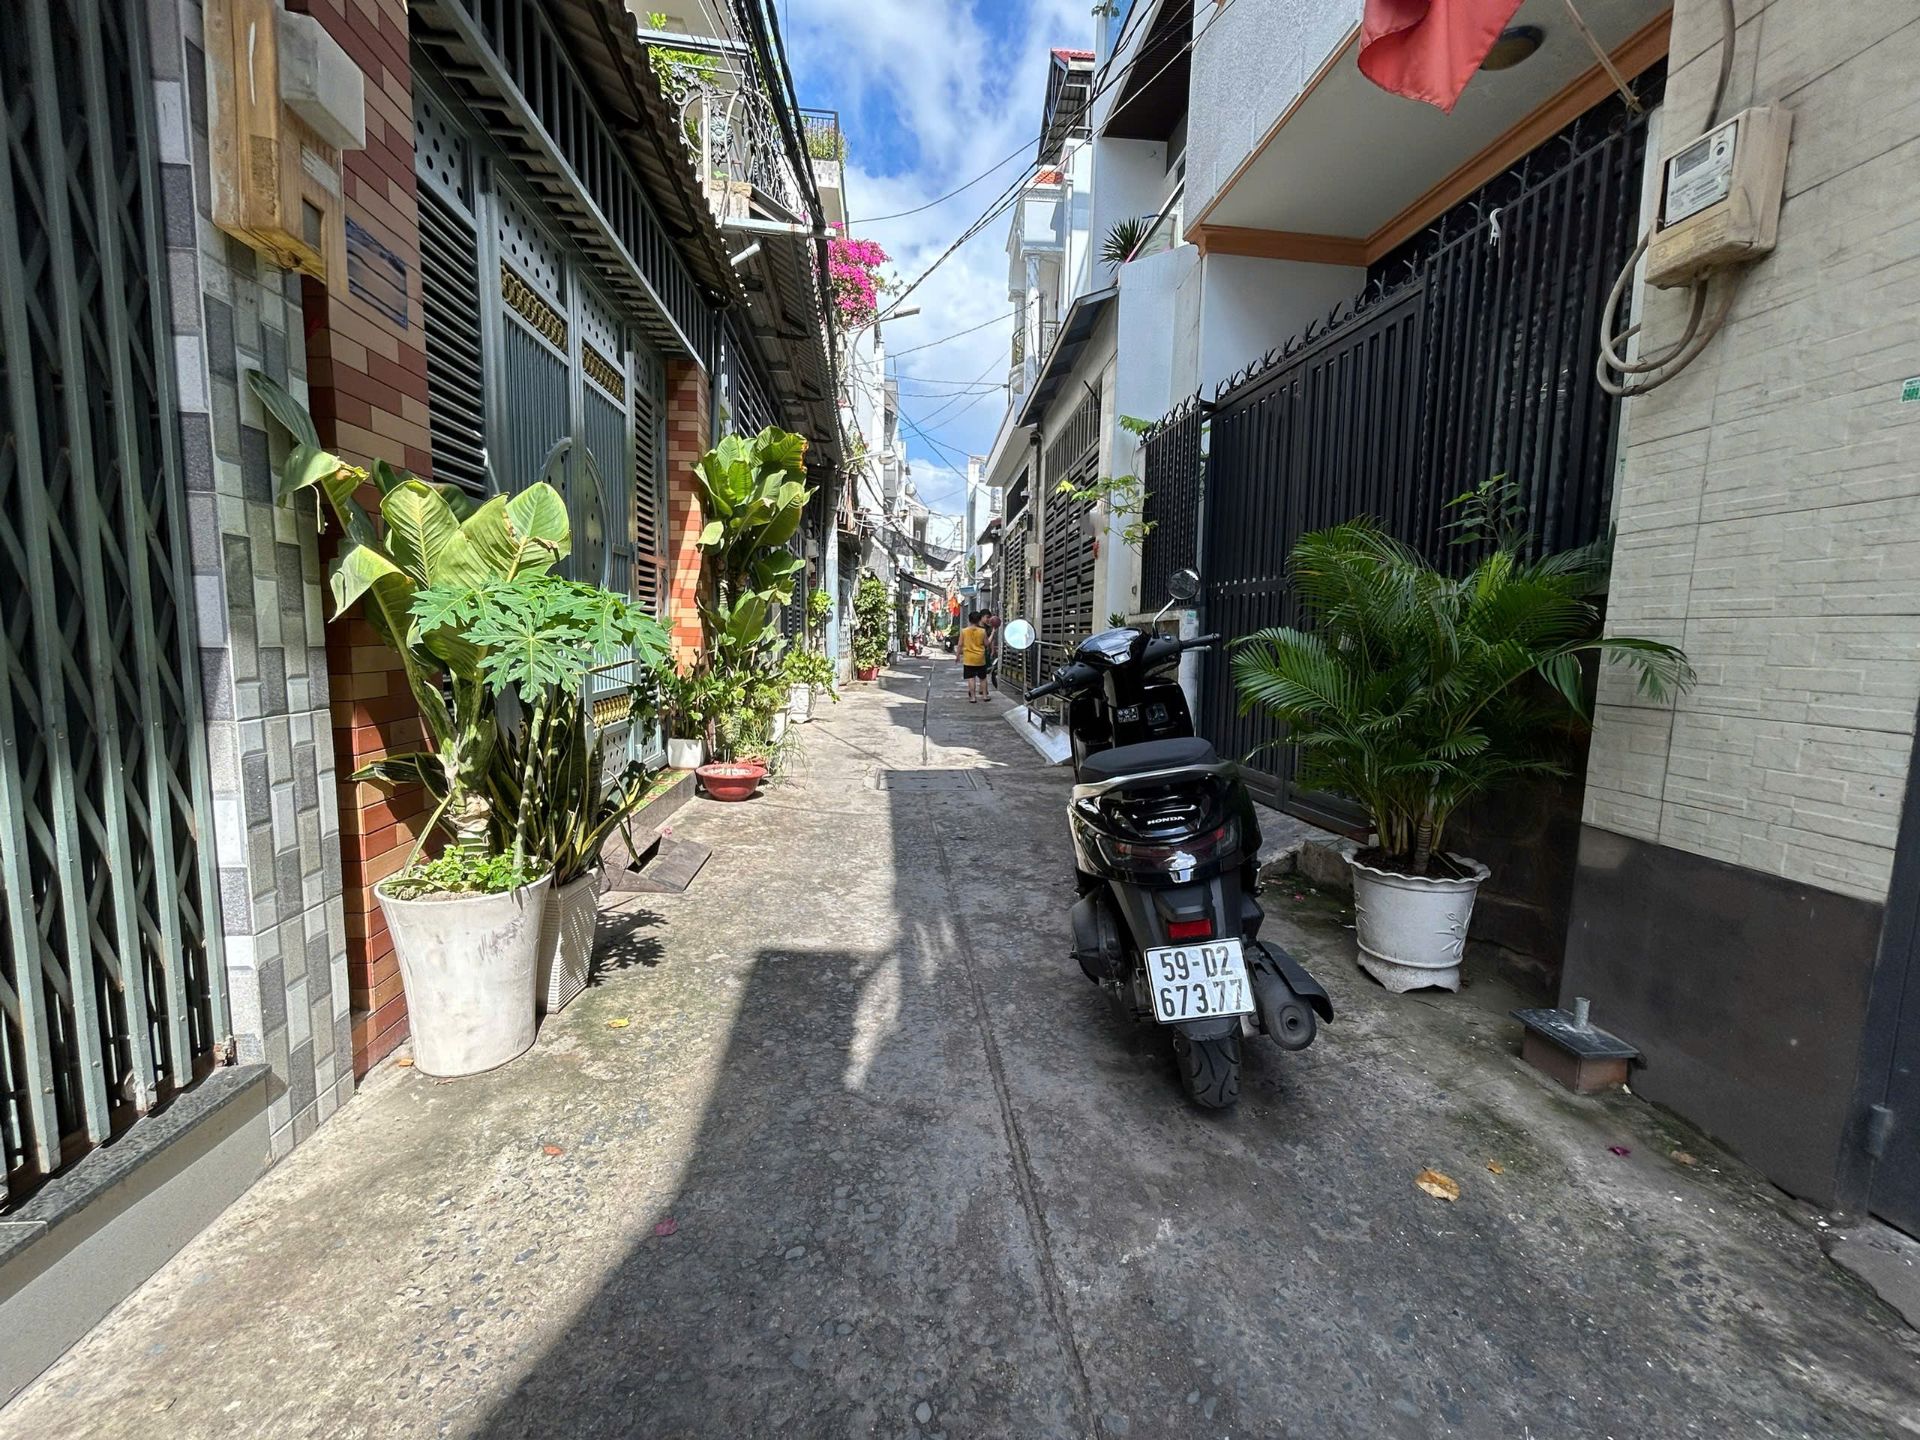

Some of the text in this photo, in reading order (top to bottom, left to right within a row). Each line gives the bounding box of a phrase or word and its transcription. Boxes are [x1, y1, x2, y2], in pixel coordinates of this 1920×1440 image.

[1147, 815, 1186, 825] HONDA
[1160, 946, 1234, 982] 59-D2
[1160, 978, 1243, 1017] 673.77
